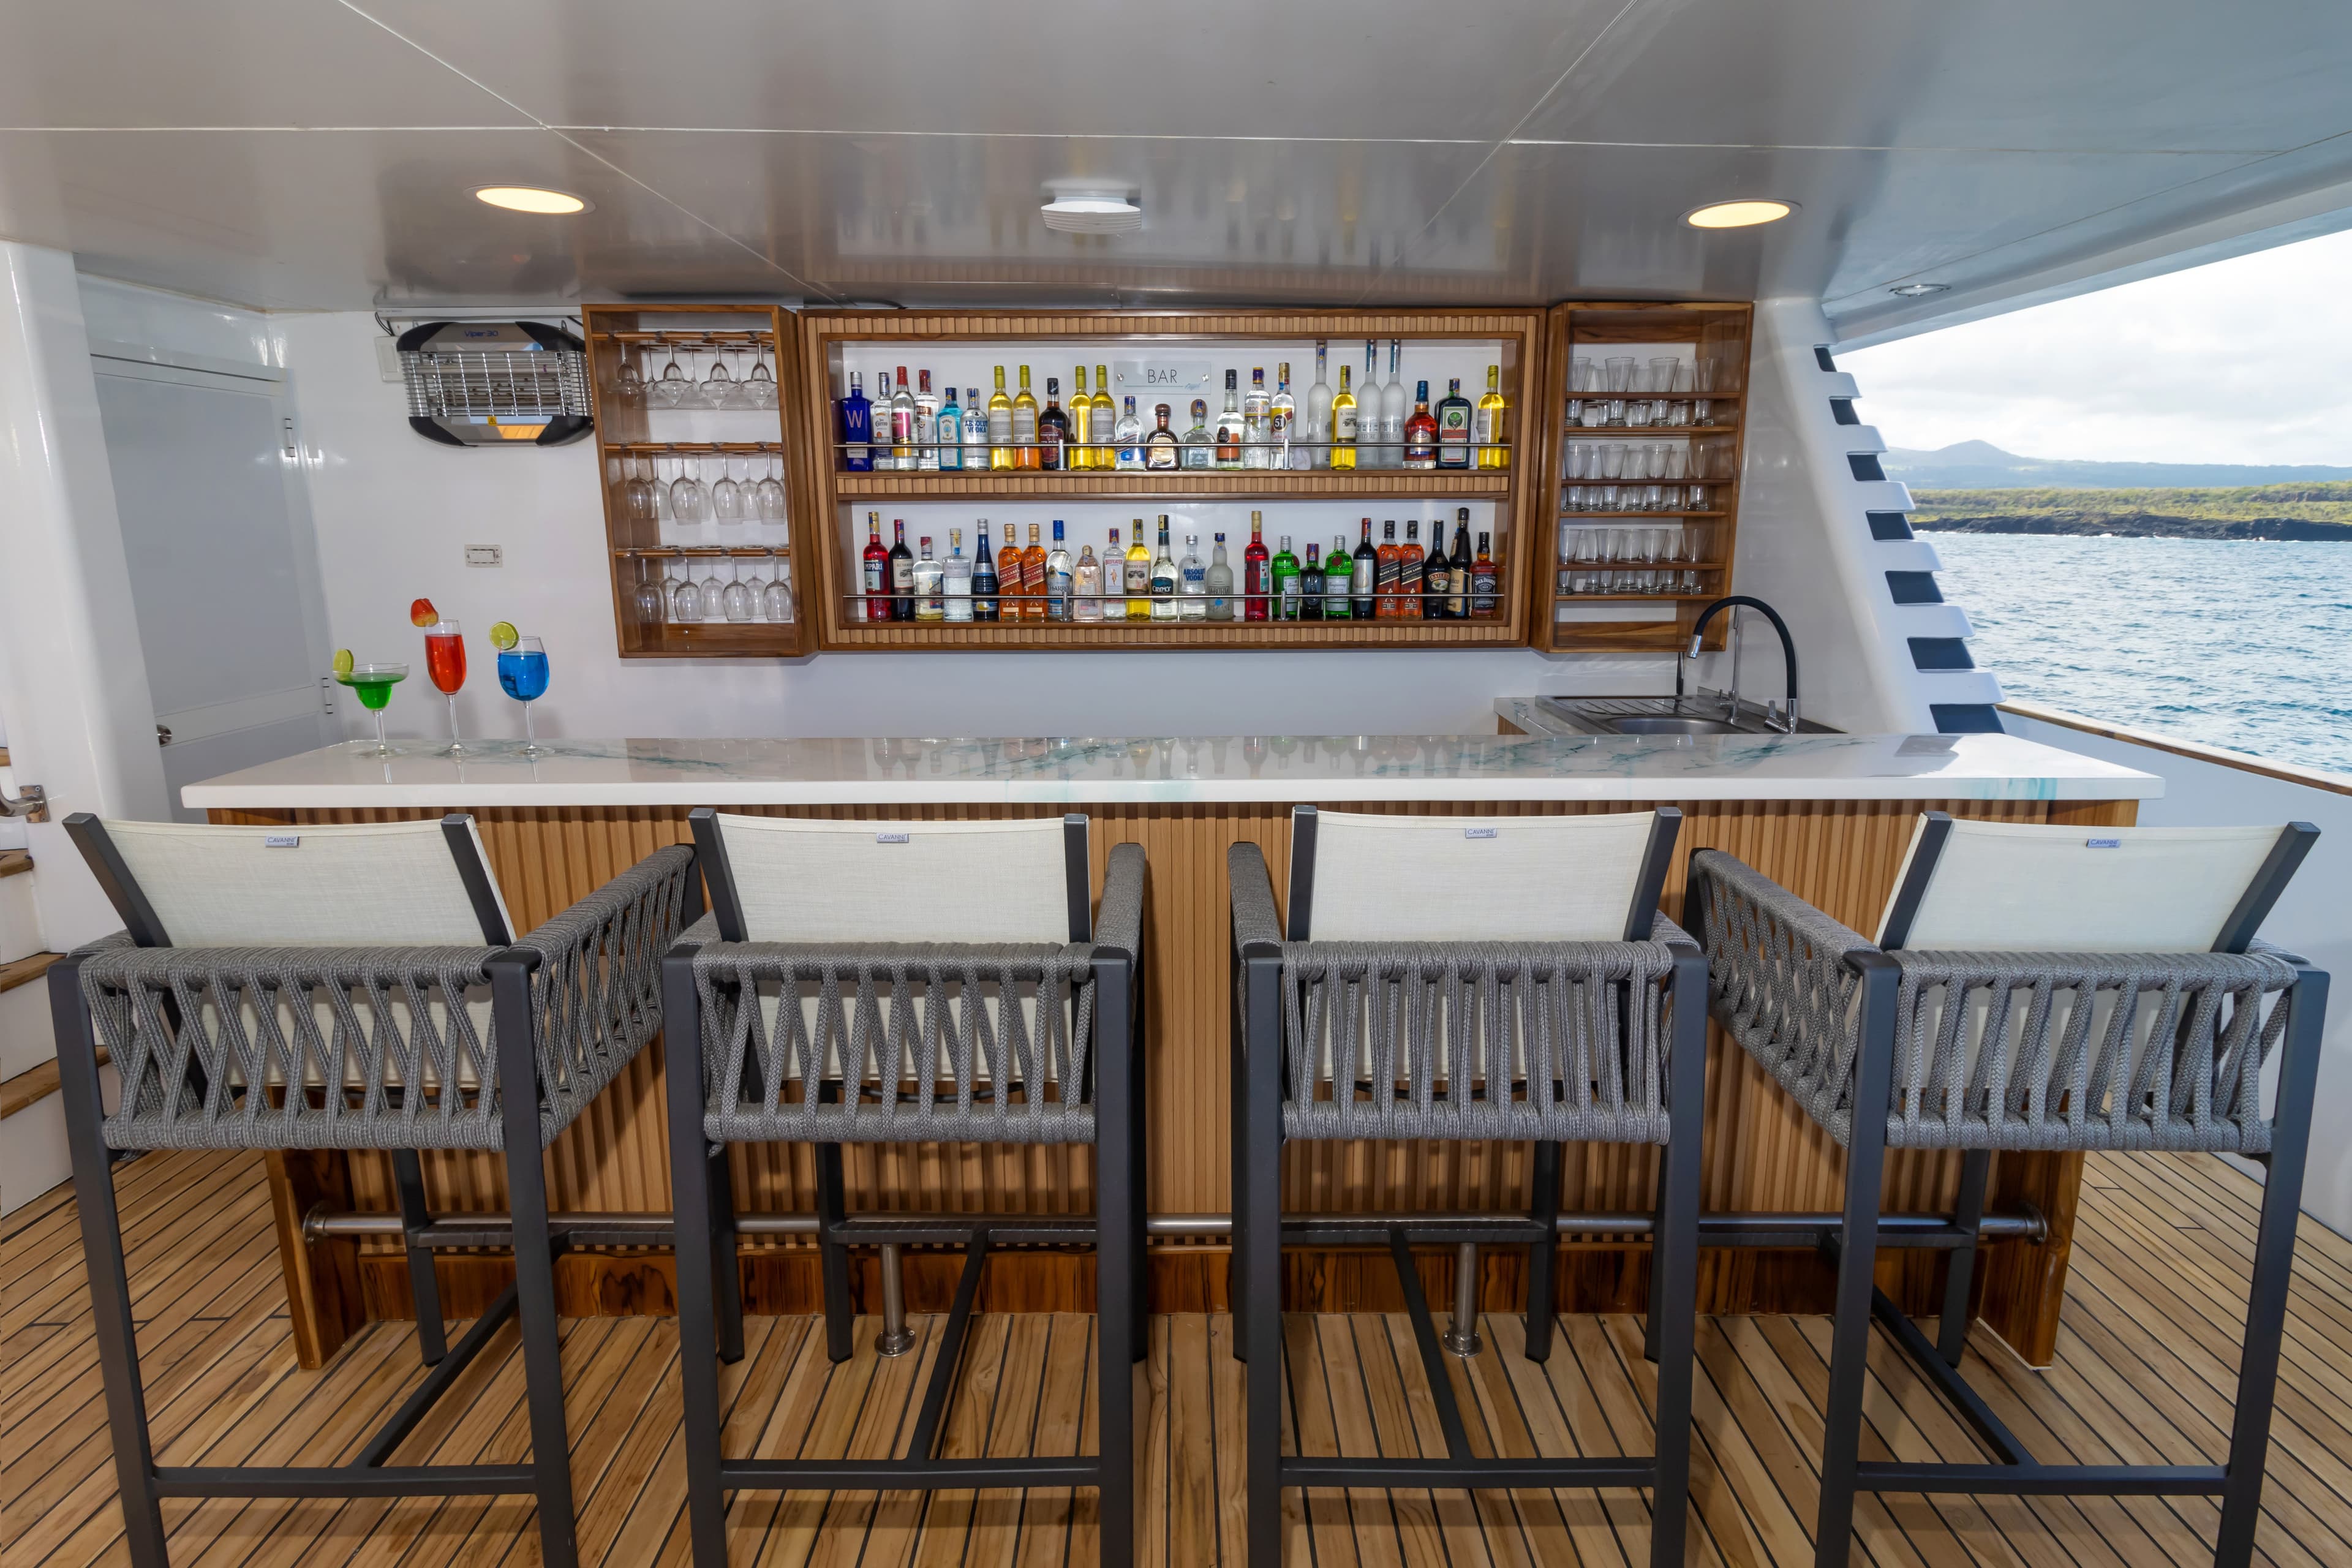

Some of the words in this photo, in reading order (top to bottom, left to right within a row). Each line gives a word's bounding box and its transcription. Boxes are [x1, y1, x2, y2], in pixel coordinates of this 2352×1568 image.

[1147, 369, 1177, 383] BAR
[846, 410, 863, 428] W
[1275, 418, 1284, 428] 51
